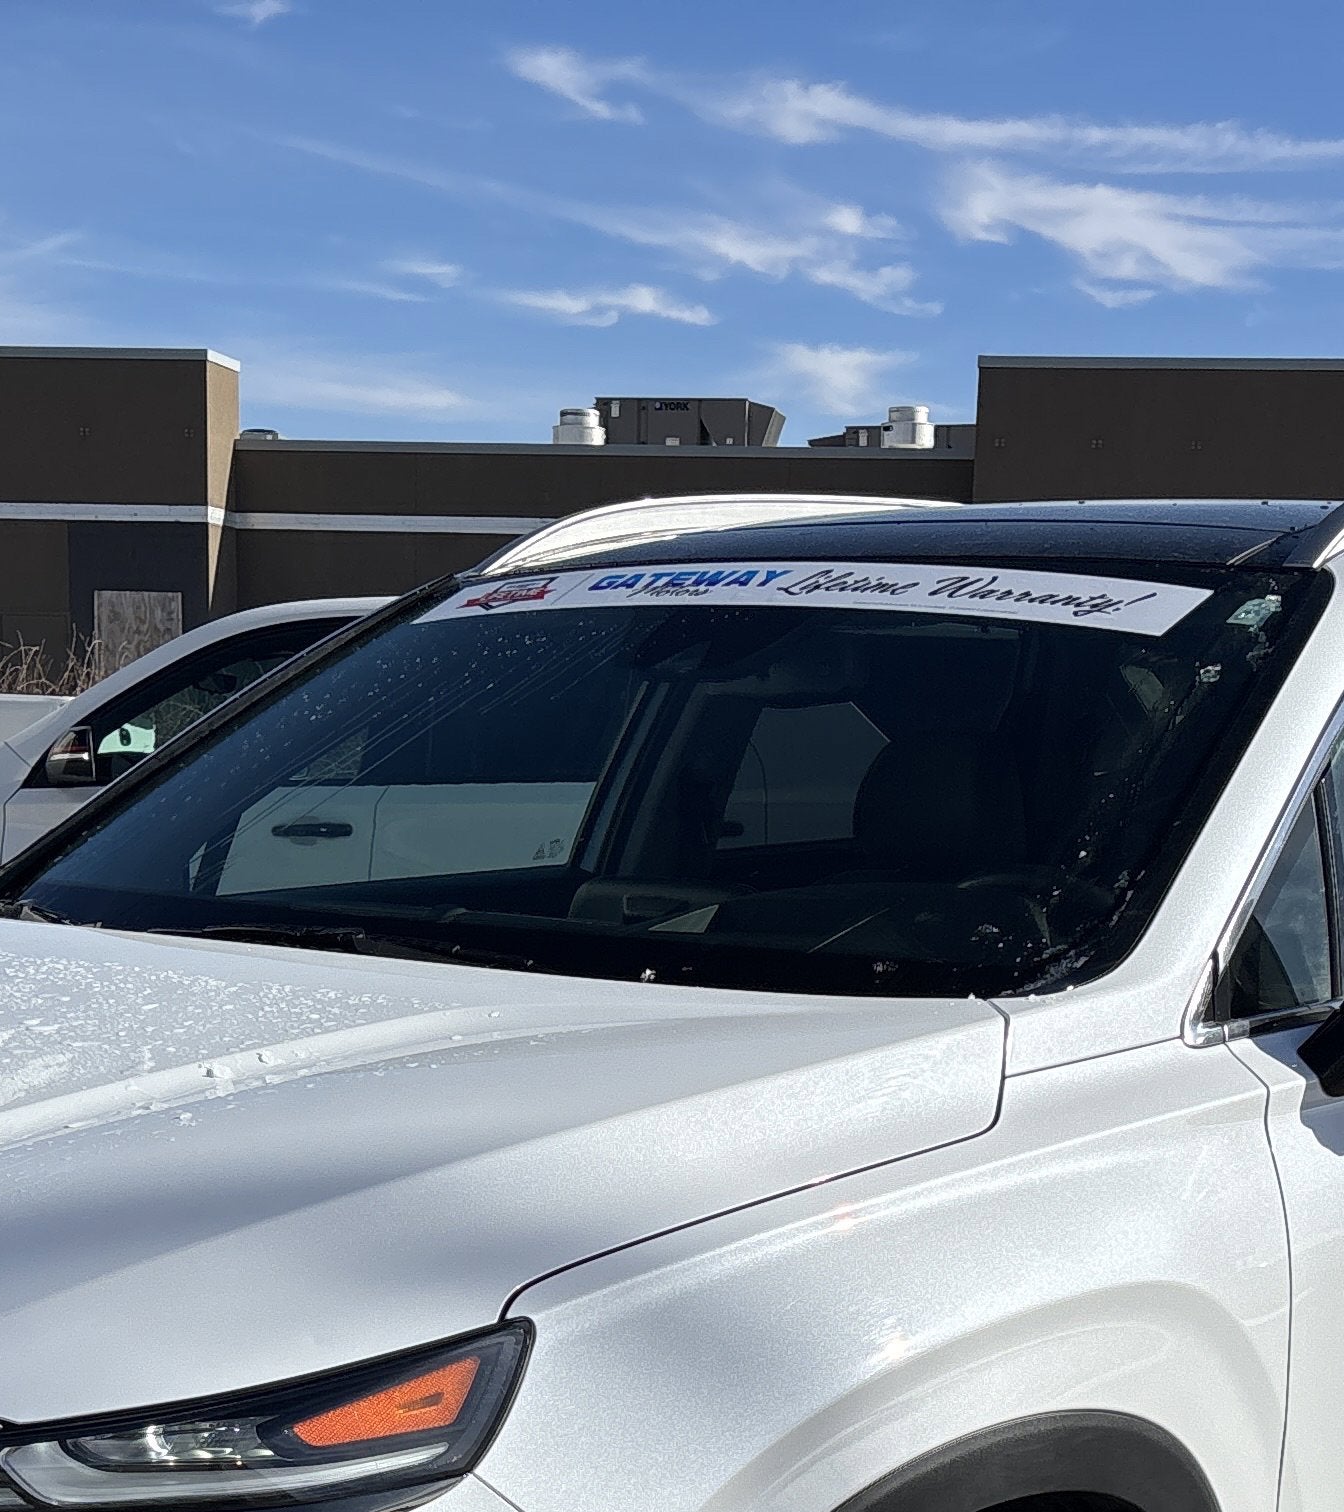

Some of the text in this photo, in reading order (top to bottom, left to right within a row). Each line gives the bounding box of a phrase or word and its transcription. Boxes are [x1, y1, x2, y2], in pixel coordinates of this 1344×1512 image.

[588, 570, 794, 592] GATEWAY
[777, 569, 921, 597] Lifetime
[928, 575, 1158, 618] Warranty!
